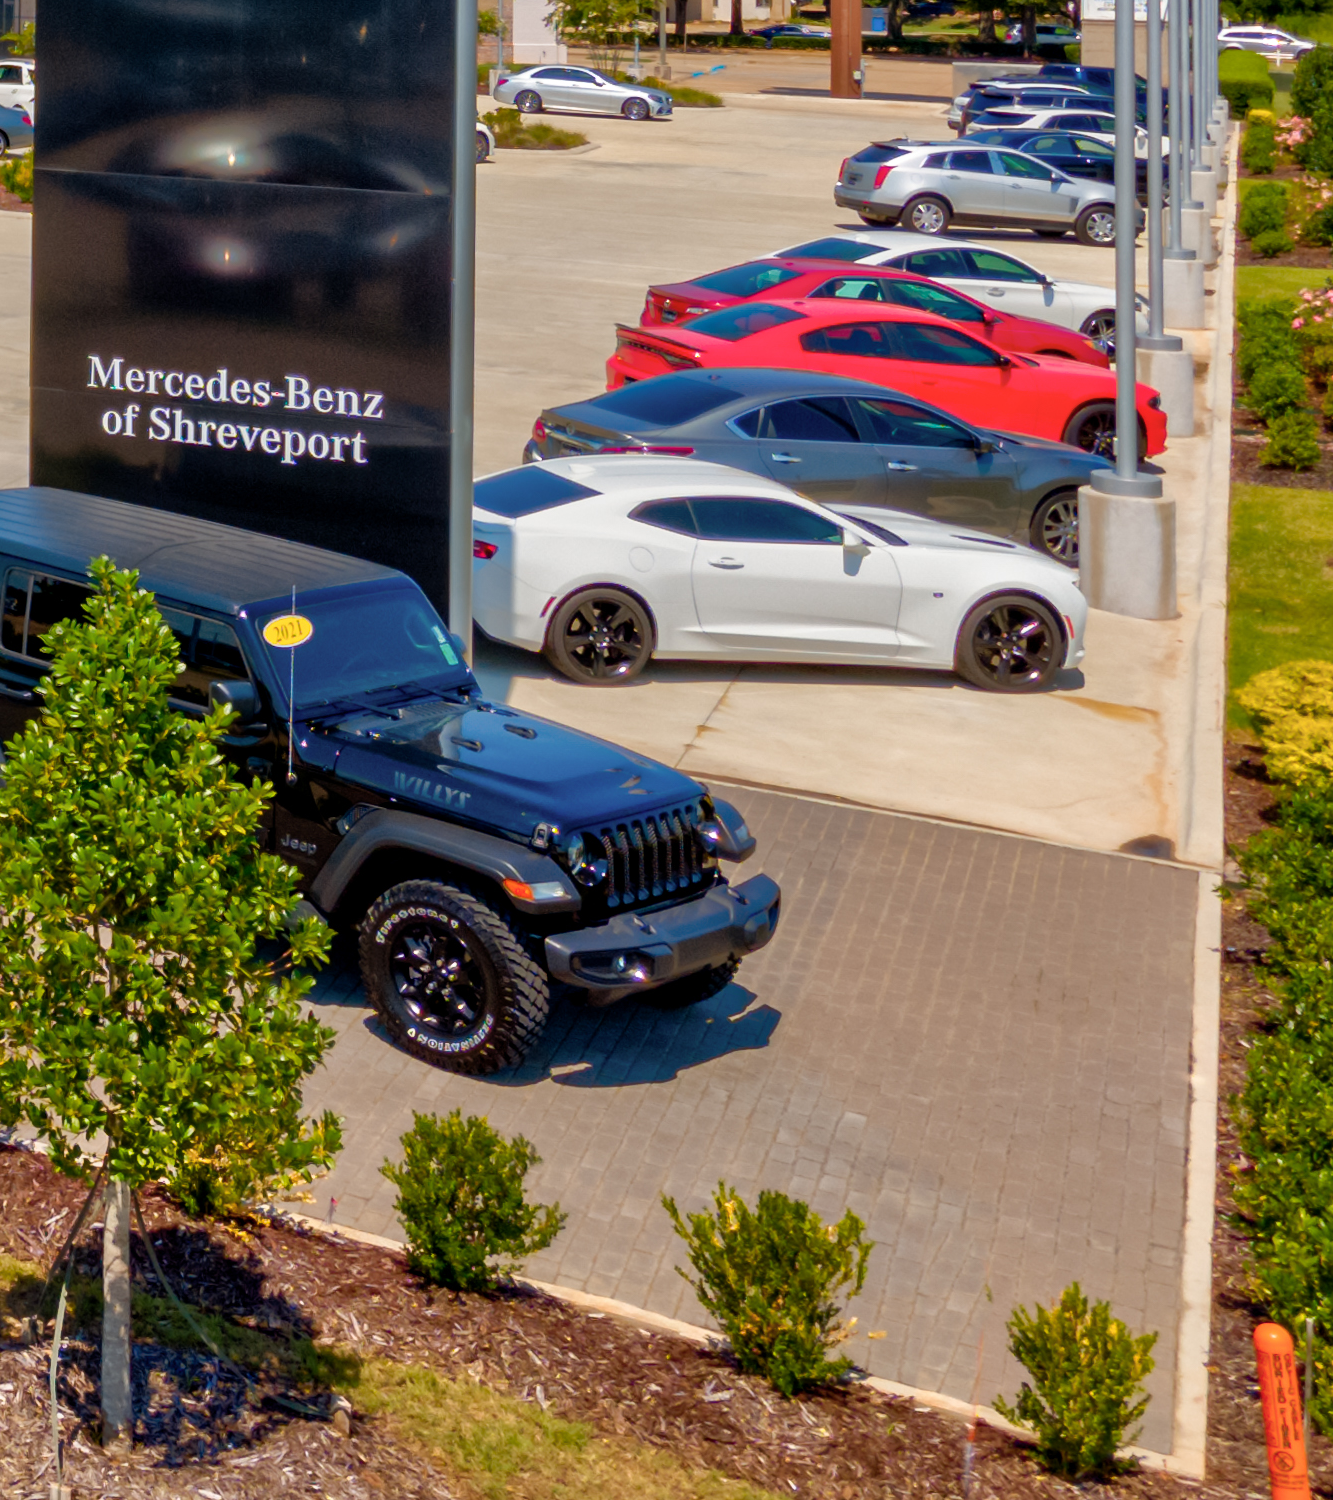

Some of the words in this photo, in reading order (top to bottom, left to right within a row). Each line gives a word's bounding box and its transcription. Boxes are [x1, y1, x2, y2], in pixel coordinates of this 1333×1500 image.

[87, 355, 384, 420] Mercedes-Benz
[102, 405, 140, 437] of
[148, 407, 368, 465] Shreveport
[273, 619, 303, 642] 2021
[394, 771, 471, 809] WILLYS
[280, 833, 318, 856] Jeep
